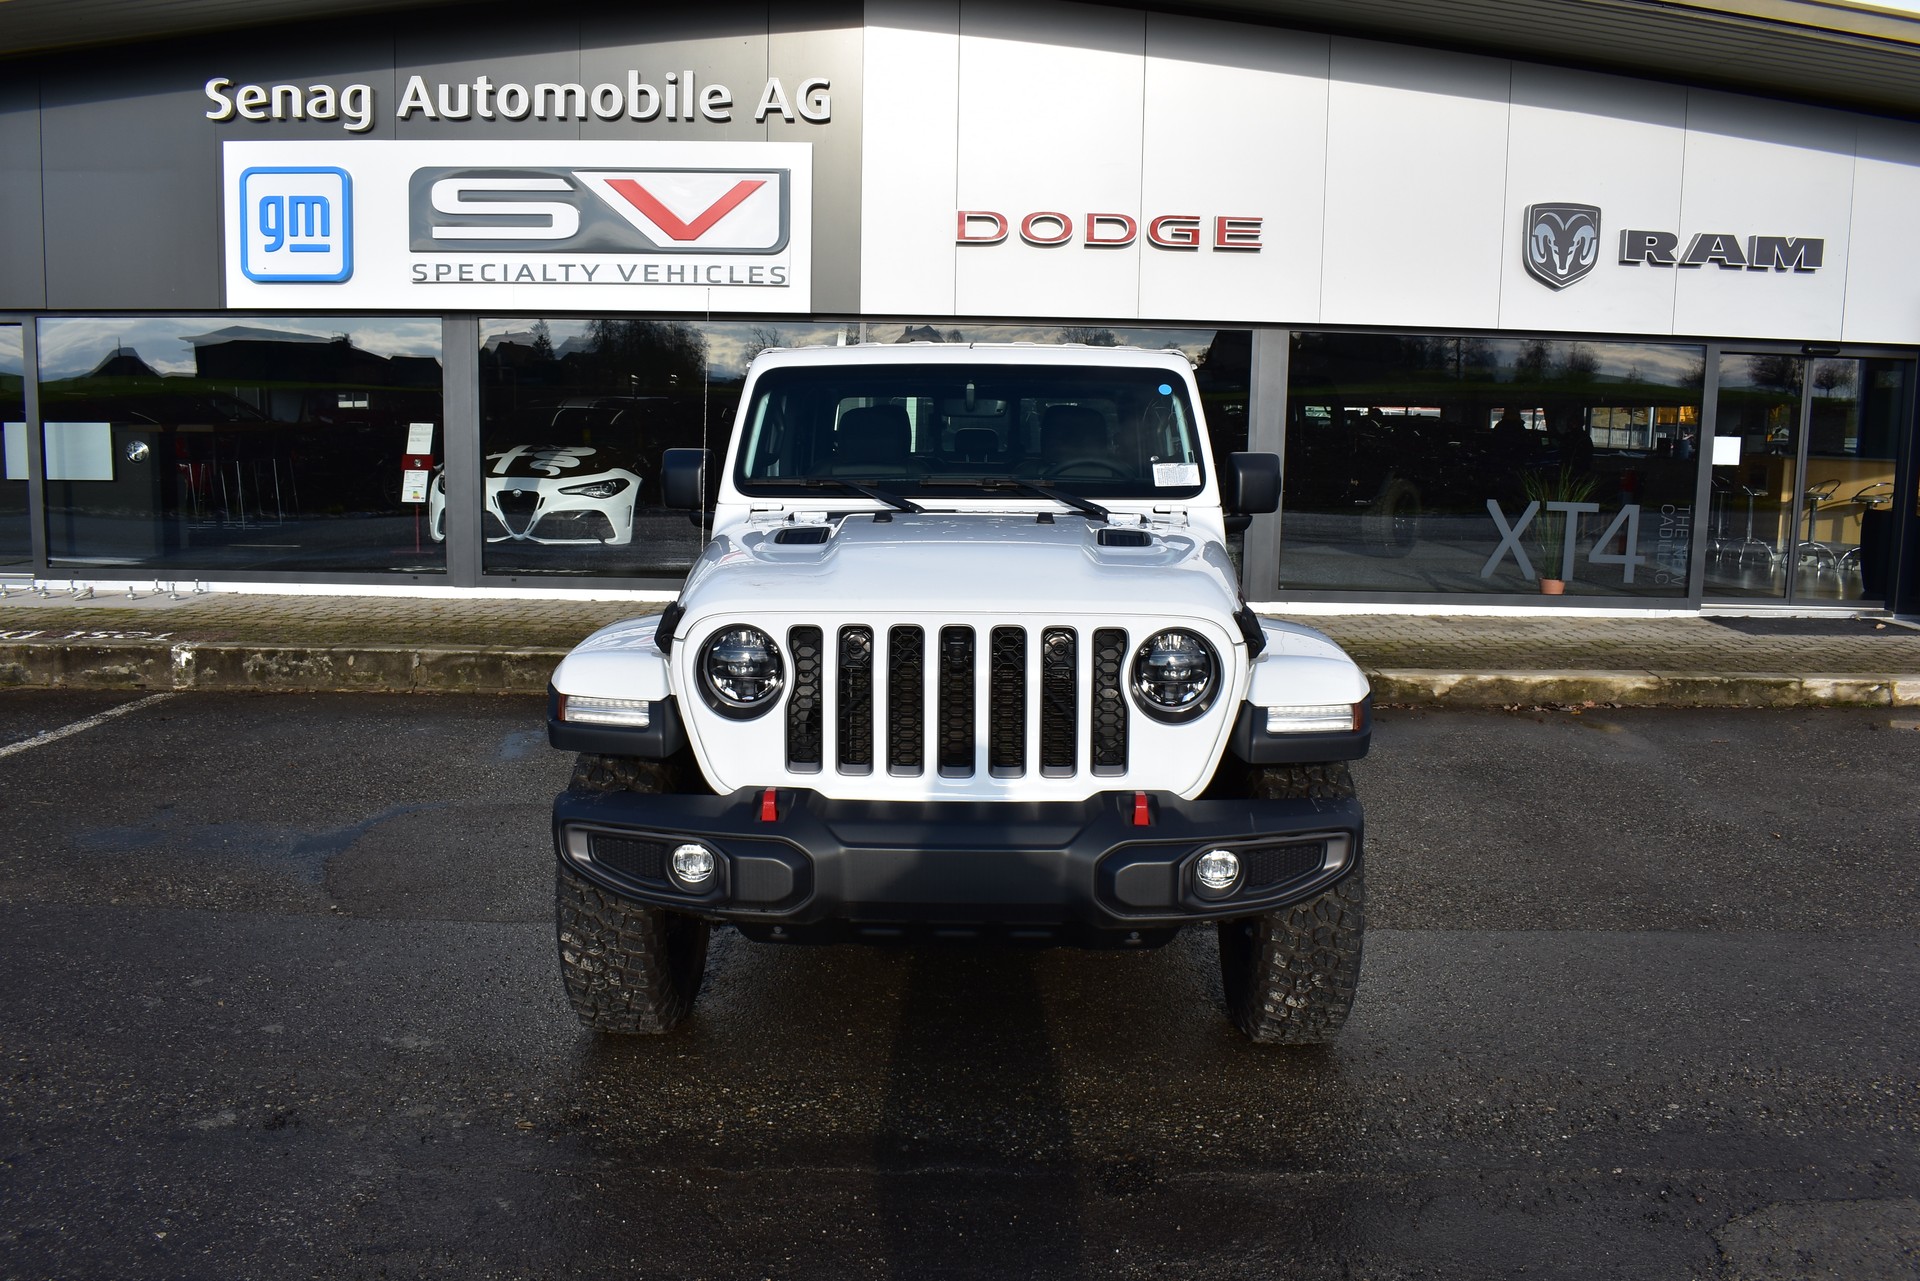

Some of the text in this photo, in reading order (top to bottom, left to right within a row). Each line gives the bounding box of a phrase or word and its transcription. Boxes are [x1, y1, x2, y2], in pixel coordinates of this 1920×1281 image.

[205, 70, 832, 132] Senag Automobile AG
[259, 195, 330, 252] gm
[432, 178, 767, 241] SV
[956, 210, 1263, 252] DODGE
[412, 263, 787, 285] SPECIALTY VEHICLES
[1619, 229, 1825, 272] RAM
[1480, 499, 1646, 583] XT4
[1655, 504, 1675, 584] CADILLAC
[1674, 504, 1691, 537] THE
